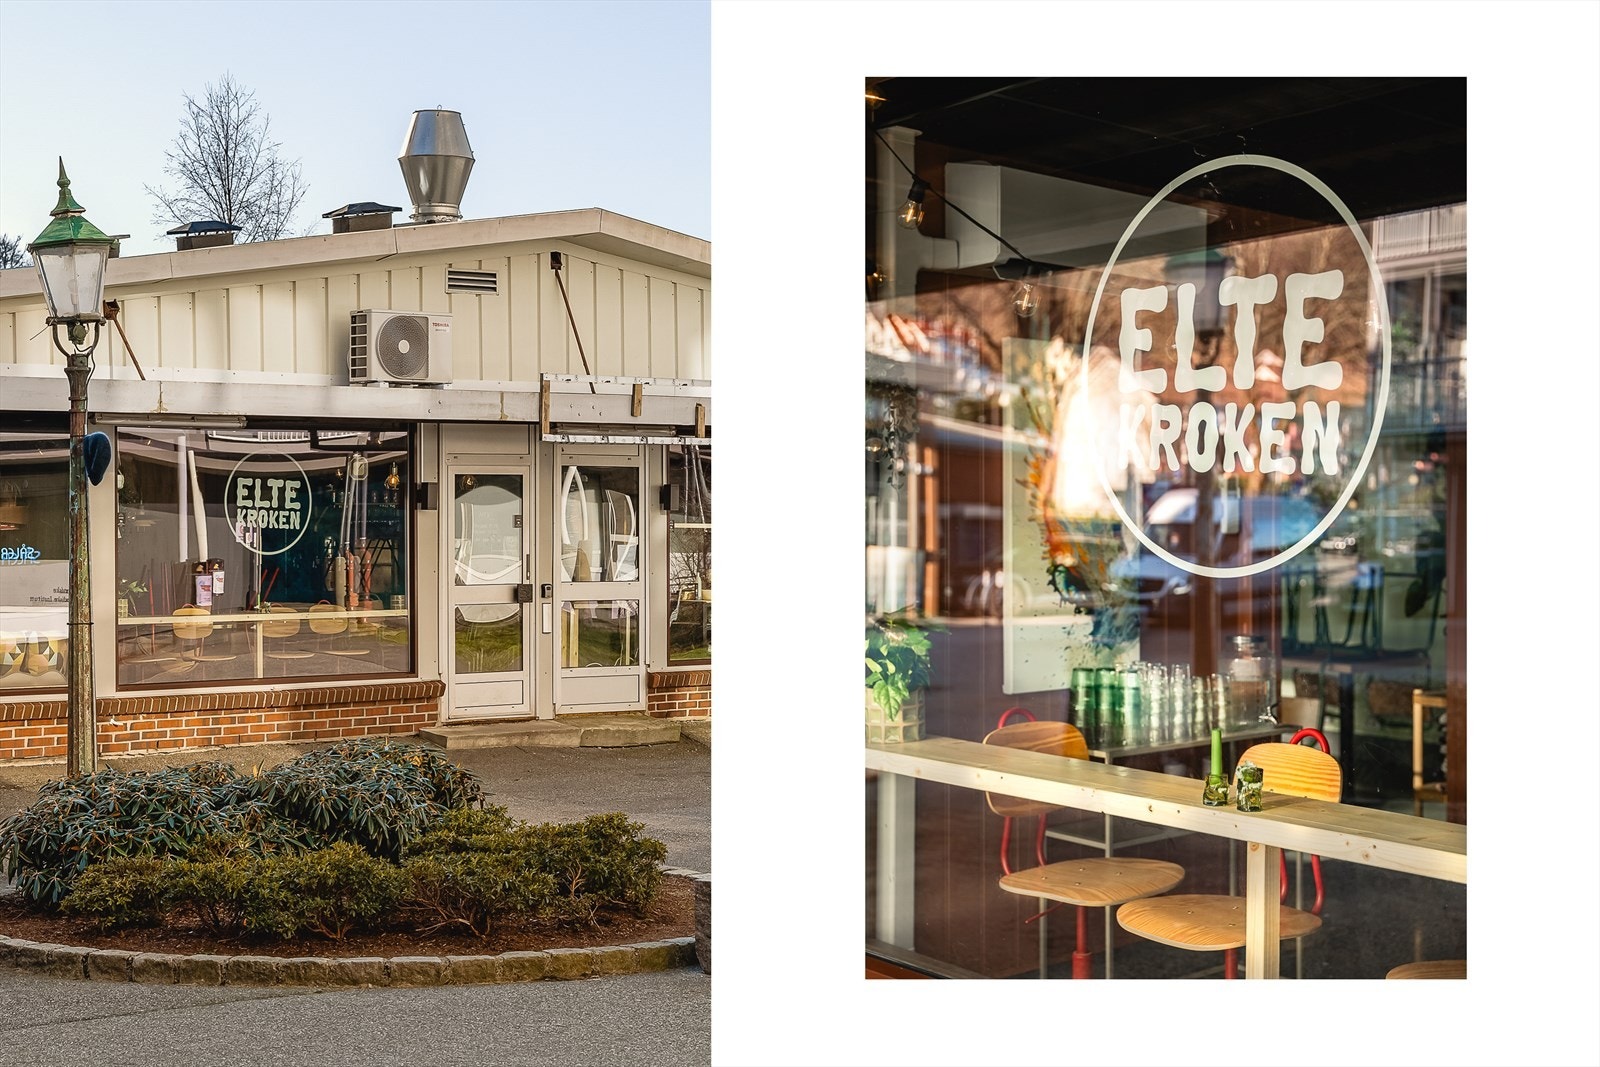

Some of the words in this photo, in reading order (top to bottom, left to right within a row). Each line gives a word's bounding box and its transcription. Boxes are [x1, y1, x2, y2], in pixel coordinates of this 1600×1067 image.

[1118, 269, 1344, 394] ELTE
[1118, 401, 1341, 476] KROKEN
[236, 477, 302, 510] ELTE
[236, 508, 301, 530] KROKEN
